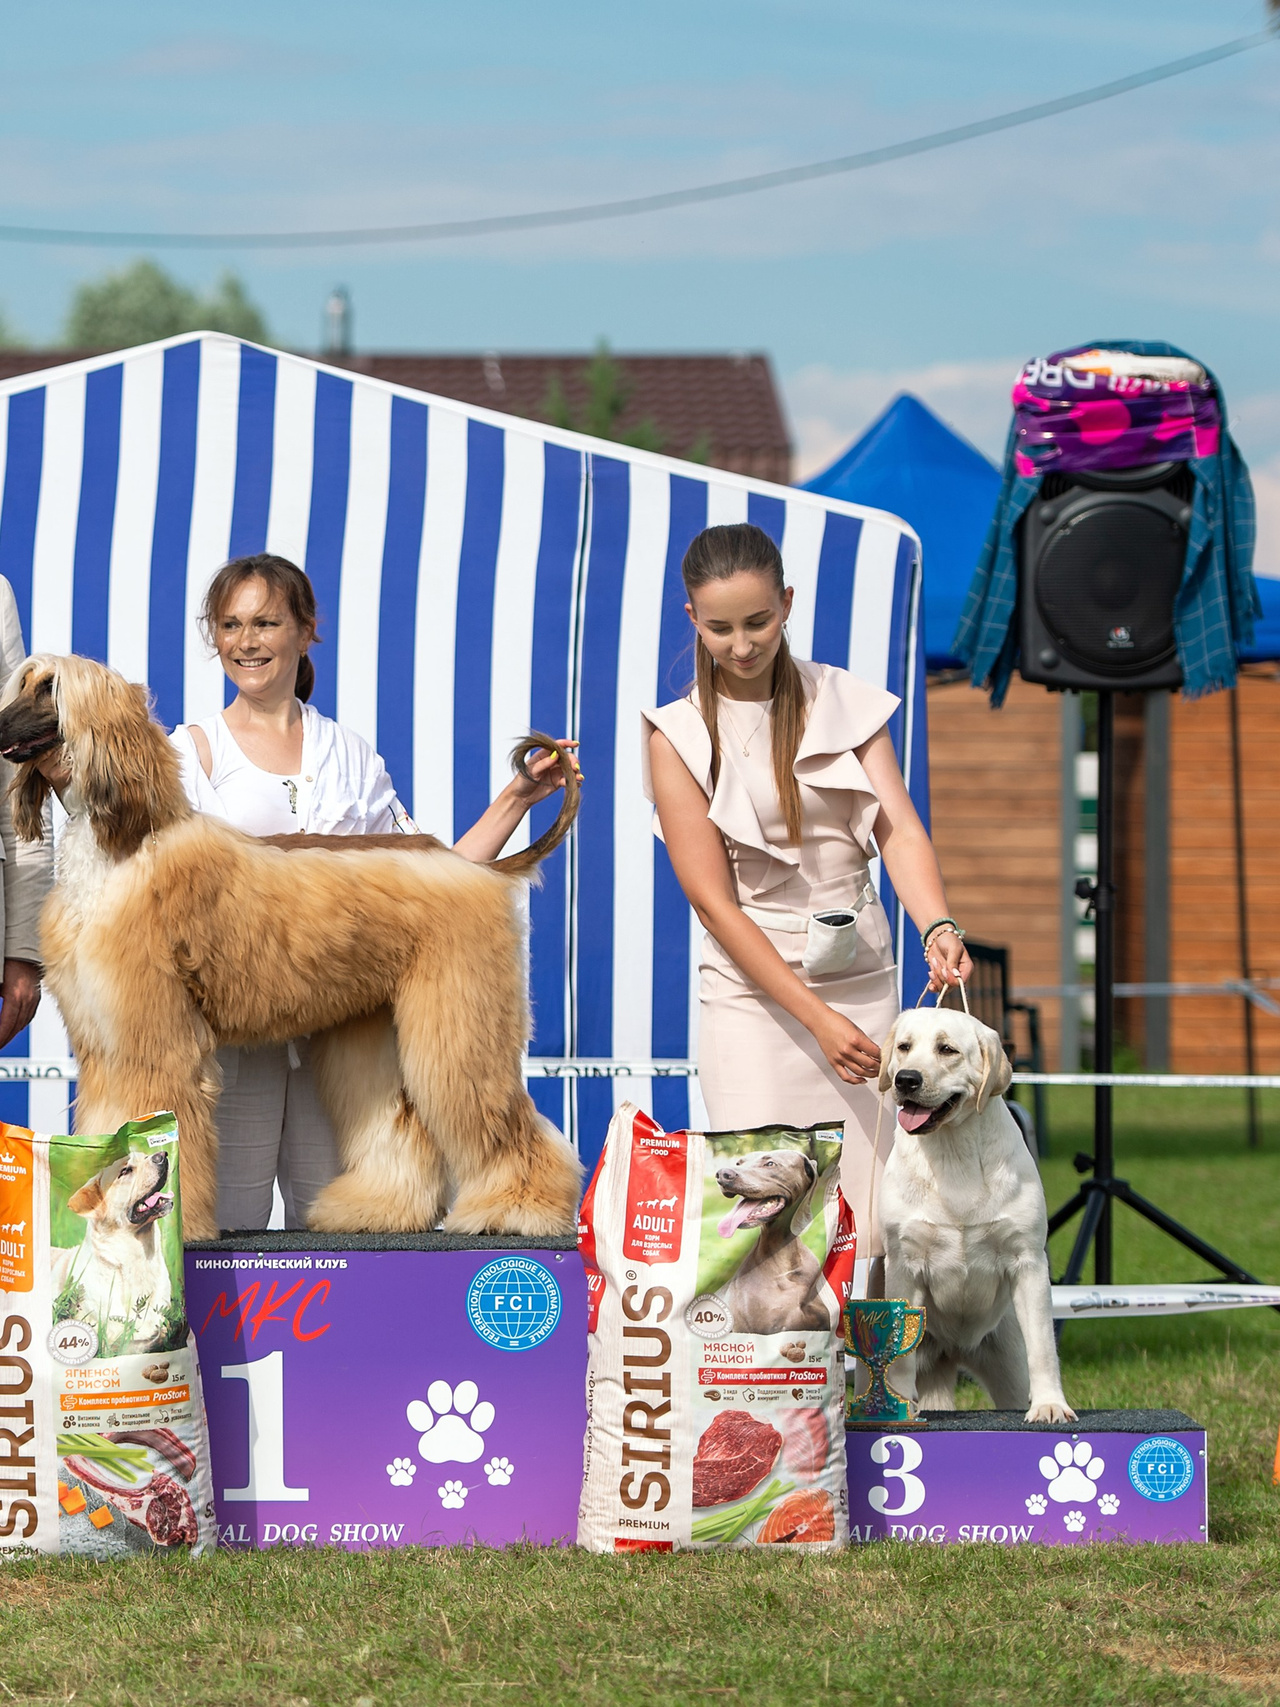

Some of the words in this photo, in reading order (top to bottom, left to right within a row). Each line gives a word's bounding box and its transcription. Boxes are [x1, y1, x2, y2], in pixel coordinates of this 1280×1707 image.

[640, 1137, 680, 1149] PREMIUM
[650, 1148, 669, 1157] FOOD
[0, 1173, 16, 1182] FOOD
[633, 1214, 675, 1234] ADULT
[631, 1239, 643, 1248] ДЛЯ
[643, 1241, 673, 1249] ВЗРОСЛЫХ
[833, 1242, 854, 1253] FOOD
[642, 1249, 660, 1257] СОБАК
[195, 1257, 312, 1269] КИНОЛОГИЧЕСКИЙ
[315, 1258, 348, 1269] КЛУБ
[473, 1258, 539, 1289] CYNOLOGIQUE
[493, 1296, 533, 1311] FCI
[527, 1269, 558, 1344] INTERNATIONALE
[469, 1288, 500, 1344] FEDERATION
[694, 1311, 725, 1324] 40%
[58, 1336, 90, 1350] 44%
[703, 1342, 755, 1353] МЯСНОЙ
[704, 1354, 753, 1364] РАЦИОН
[808, 1355, 815, 1363] 15
[65, 1367, 120, 1378] ЯГНЕНОК
[172, 1374, 179, 1382] 15
[716, 1372, 748, 1380] Комплекс
[749, 1371, 787, 1381] пробиотиков
[789, 1370, 825, 1381] ProStor+
[65, 1380, 74, 1390] С
[77, 1378, 121, 1389] РИСОМ
[78, 1397, 110, 1406] Комплекс
[110, 1395, 150, 1406] пробиотиков
[152, 1390, 187, 1402] ProStor+
[620, 1285, 673, 1512] SIRIUS
[220, 1350, 310, 1502] 1
[1133, 1437, 1179, 1459] CYNOLOGIQUE
[1147, 1463, 1175, 1474] FCI
[1170, 1445, 1192, 1497] INTERNATIONALE
[867, 1434, 927, 1517] 3
[1131, 1459, 1152, 1498] FEDERATION
[619, 1518, 670, 1530] PREMIUM
[262, 1524, 319, 1542] DOG
[329, 1523, 405, 1543] SHOW
[889, 1524, 946, 1543] DOG
[958, 1524, 1035, 1543] SHOW
